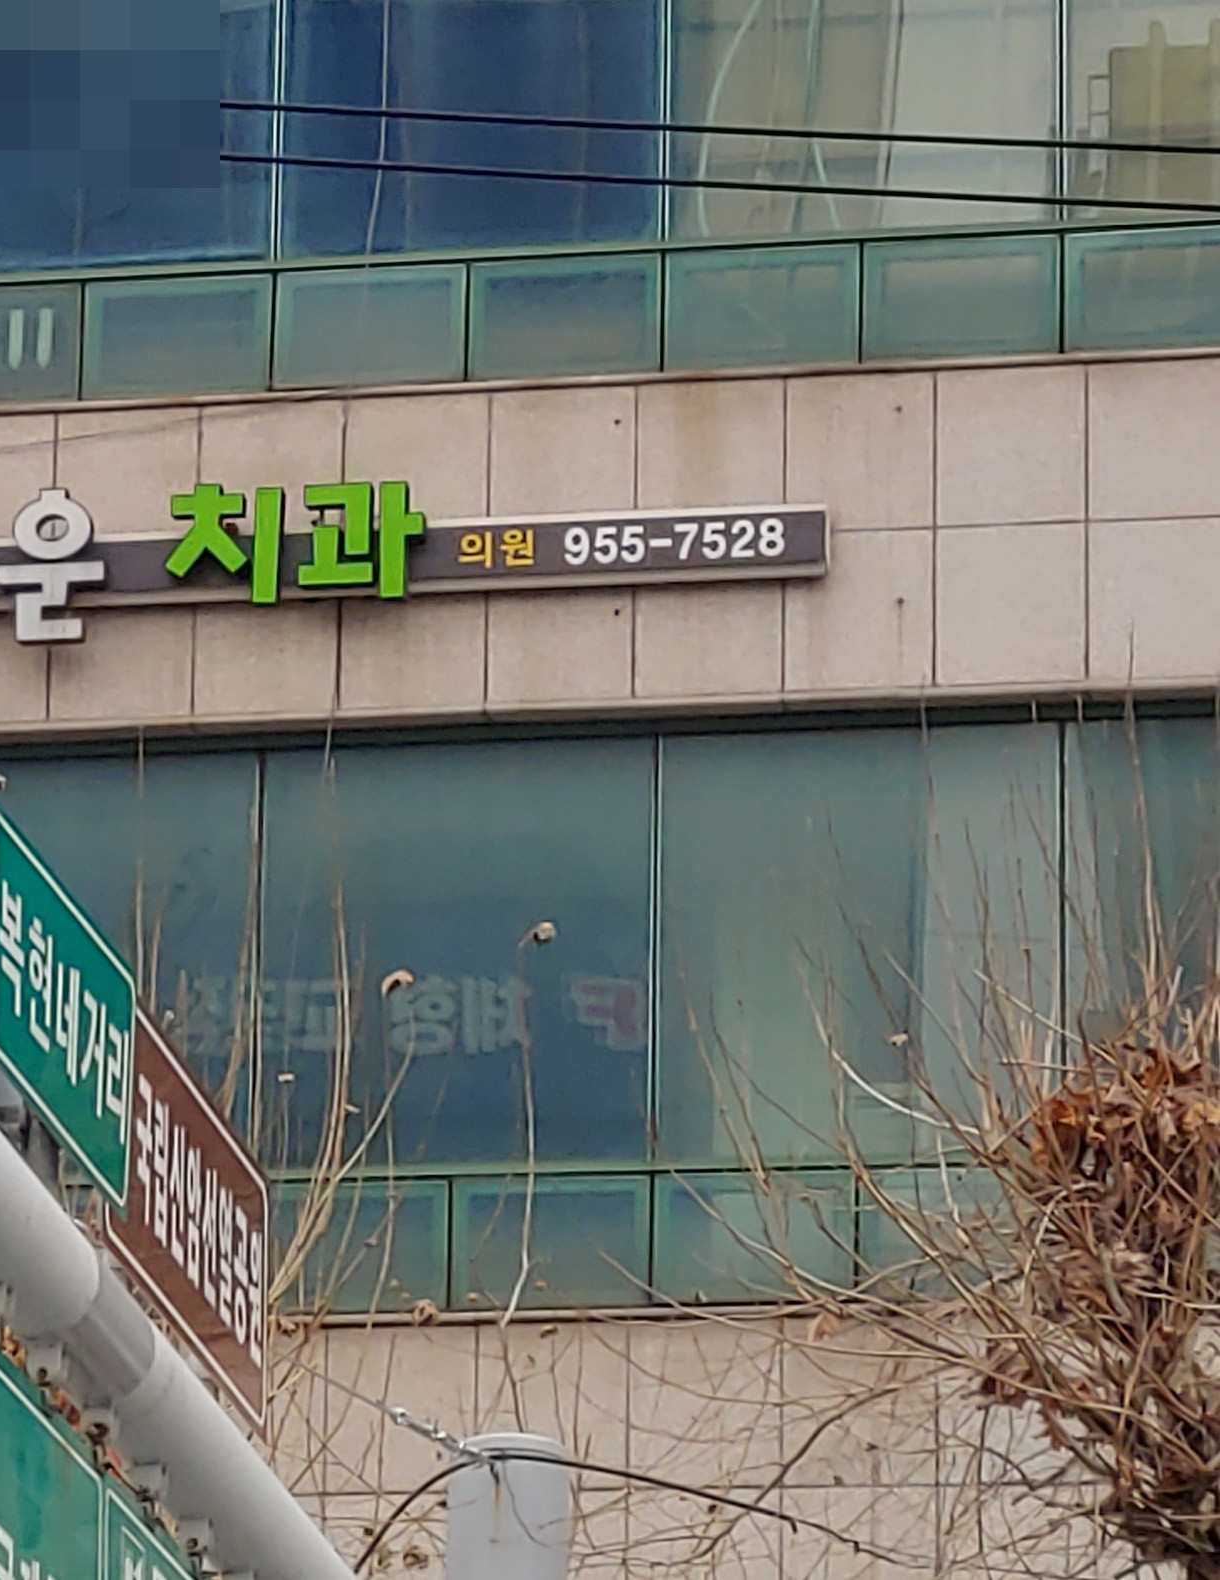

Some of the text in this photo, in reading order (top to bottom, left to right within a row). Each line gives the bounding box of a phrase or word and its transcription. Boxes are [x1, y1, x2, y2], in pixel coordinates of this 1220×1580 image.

[165, 480, 426, 604] 치과
[457, 528, 536, 570] 의원
[563, 518, 787, 566] 955-7528
[136, 1073, 263, 1370] 국립신암선열공원
